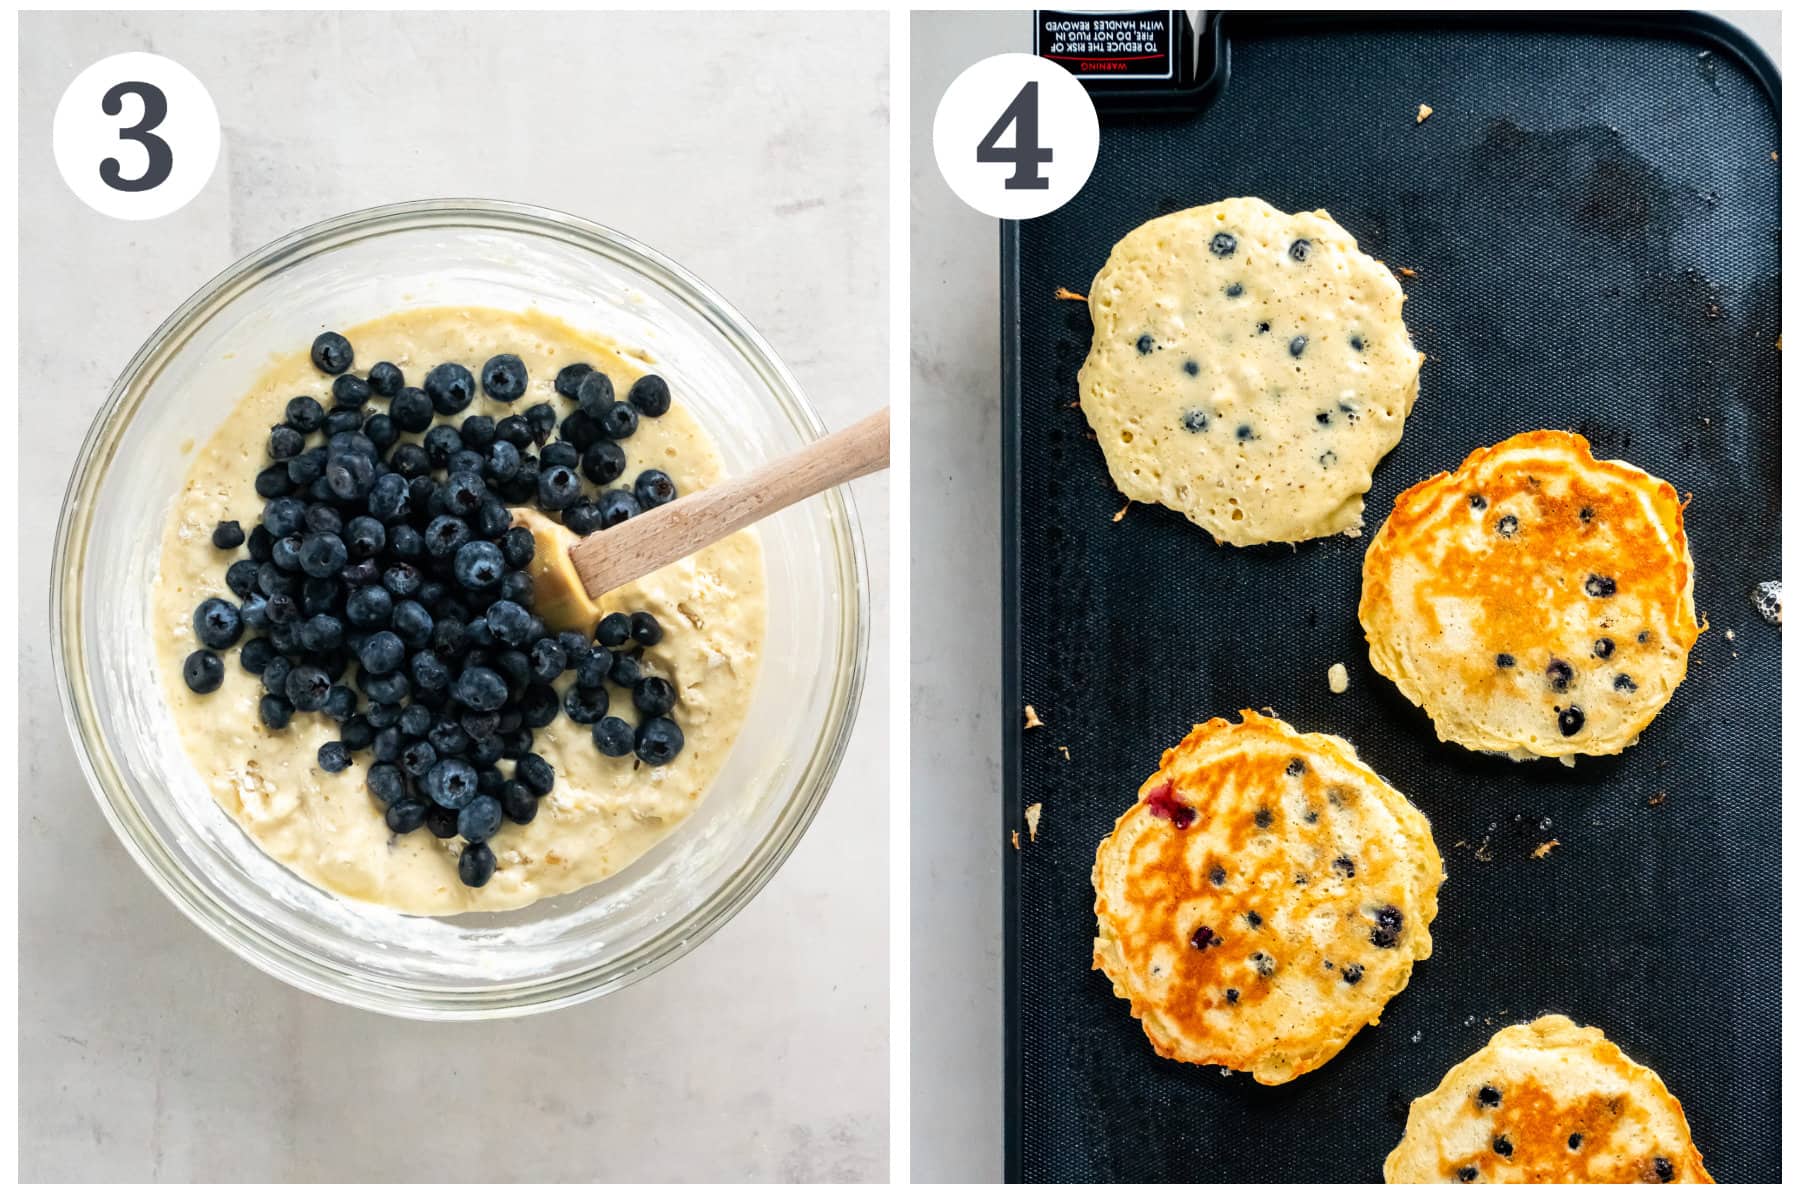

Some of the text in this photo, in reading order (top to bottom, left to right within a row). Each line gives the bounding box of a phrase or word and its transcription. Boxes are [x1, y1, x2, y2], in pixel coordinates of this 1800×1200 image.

[1045, 20, 1164, 30] WITH HANDLES REMOVED
[1068, 32, 1091, 41] PLUG
[1094, 32, 1114, 41] NOT
[1116, 32, 1131, 40] DO
[1134, 31, 1153, 40] FIRE,
[1051, 43, 1157, 52] TO REDUCE THE RISK OF
[1080, 62, 1127, 71] WARNING
